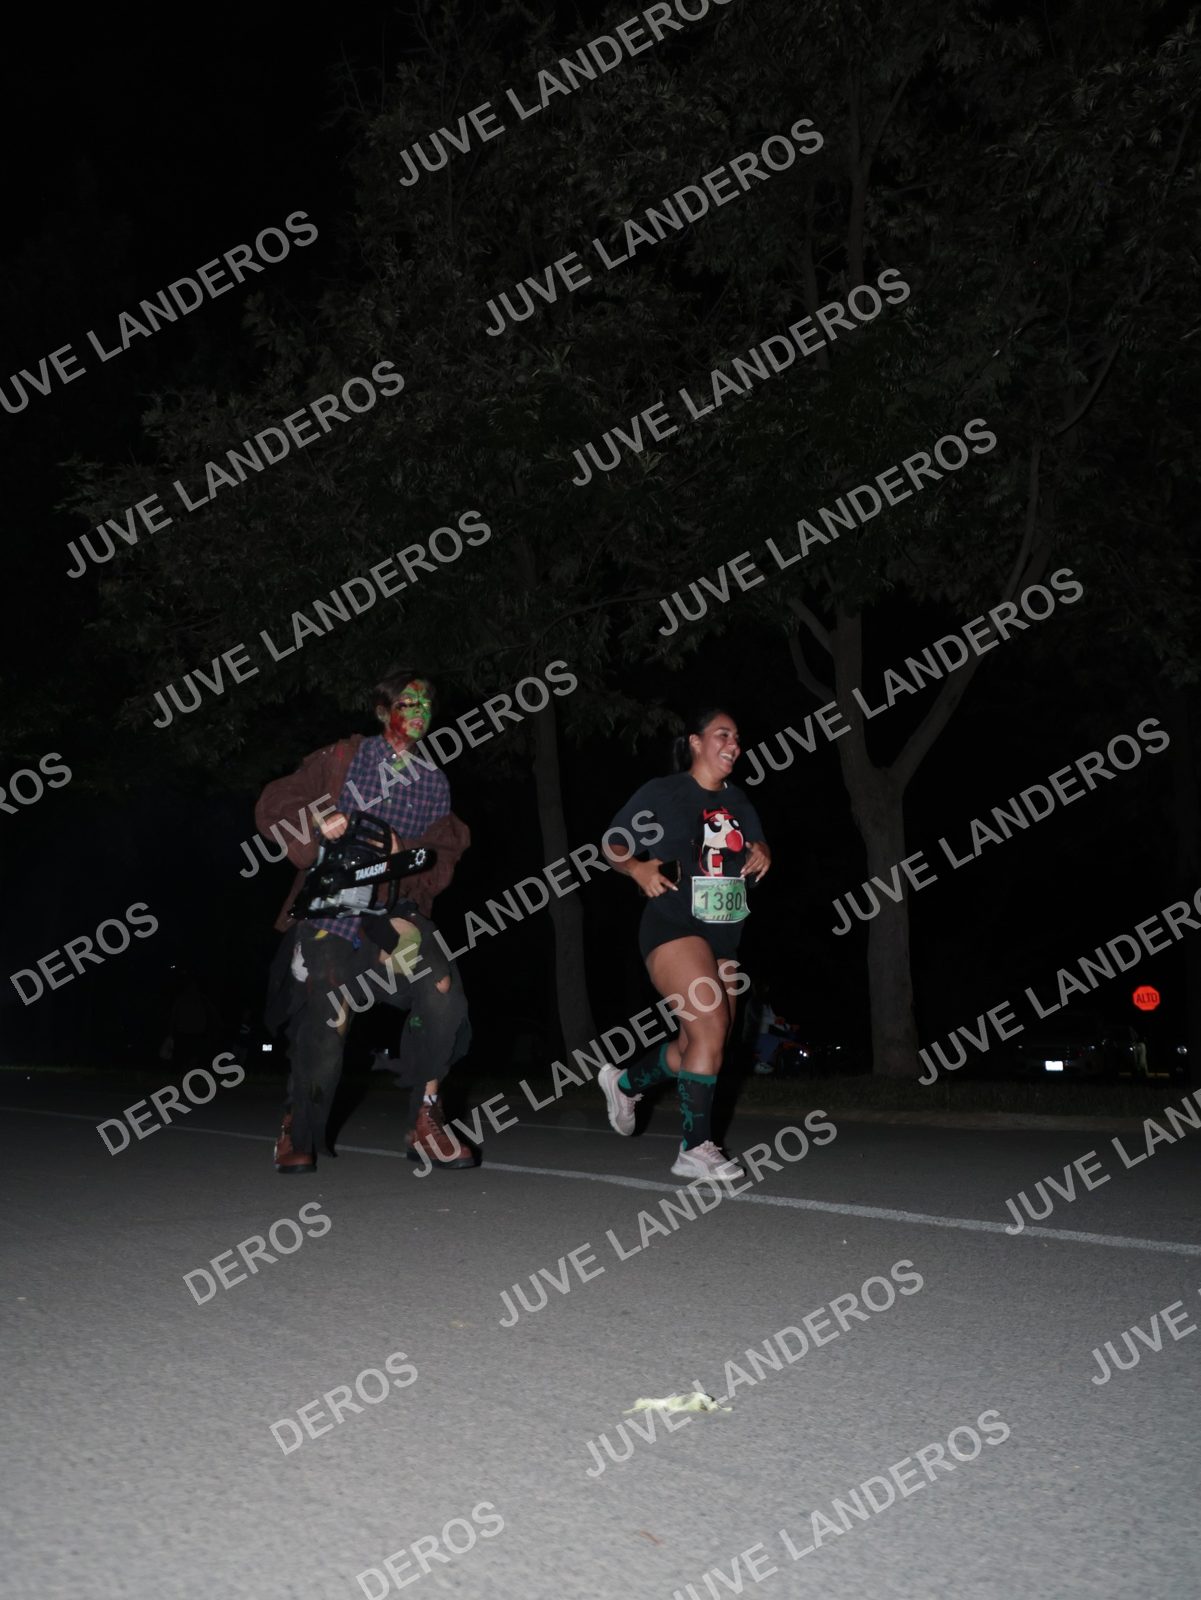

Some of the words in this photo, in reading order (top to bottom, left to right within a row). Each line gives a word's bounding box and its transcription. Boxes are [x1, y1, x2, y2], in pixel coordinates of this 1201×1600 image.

[355, 861, 388, 881] TAKASHI
[700, 891, 742, 911] 1380
[1136, 992, 1158, 1004] ALTO
